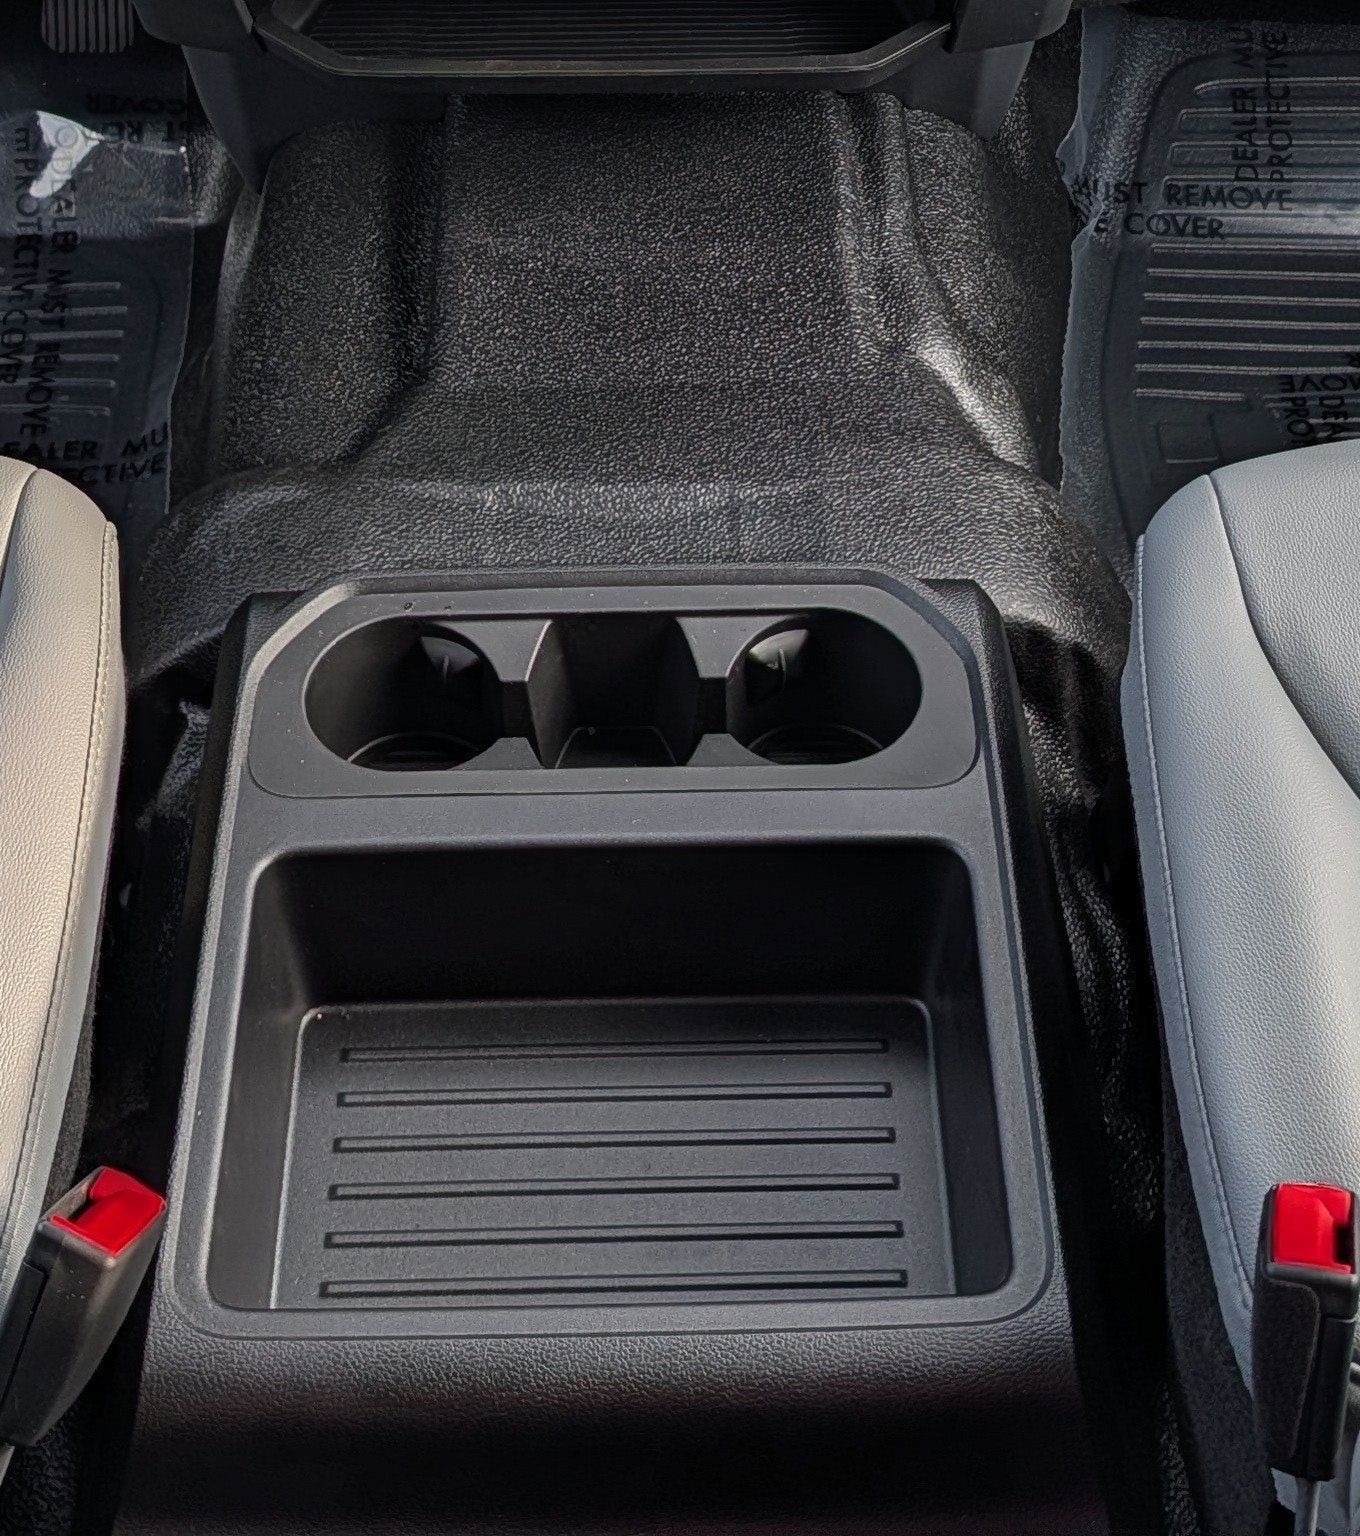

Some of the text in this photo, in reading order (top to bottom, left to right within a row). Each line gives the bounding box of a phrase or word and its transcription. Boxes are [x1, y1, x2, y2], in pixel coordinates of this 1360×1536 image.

[1231, 88, 1258, 183] DEALER
[1165, 182, 1293, 212] REMOVE
[1123, 212, 1225, 240] COVER
